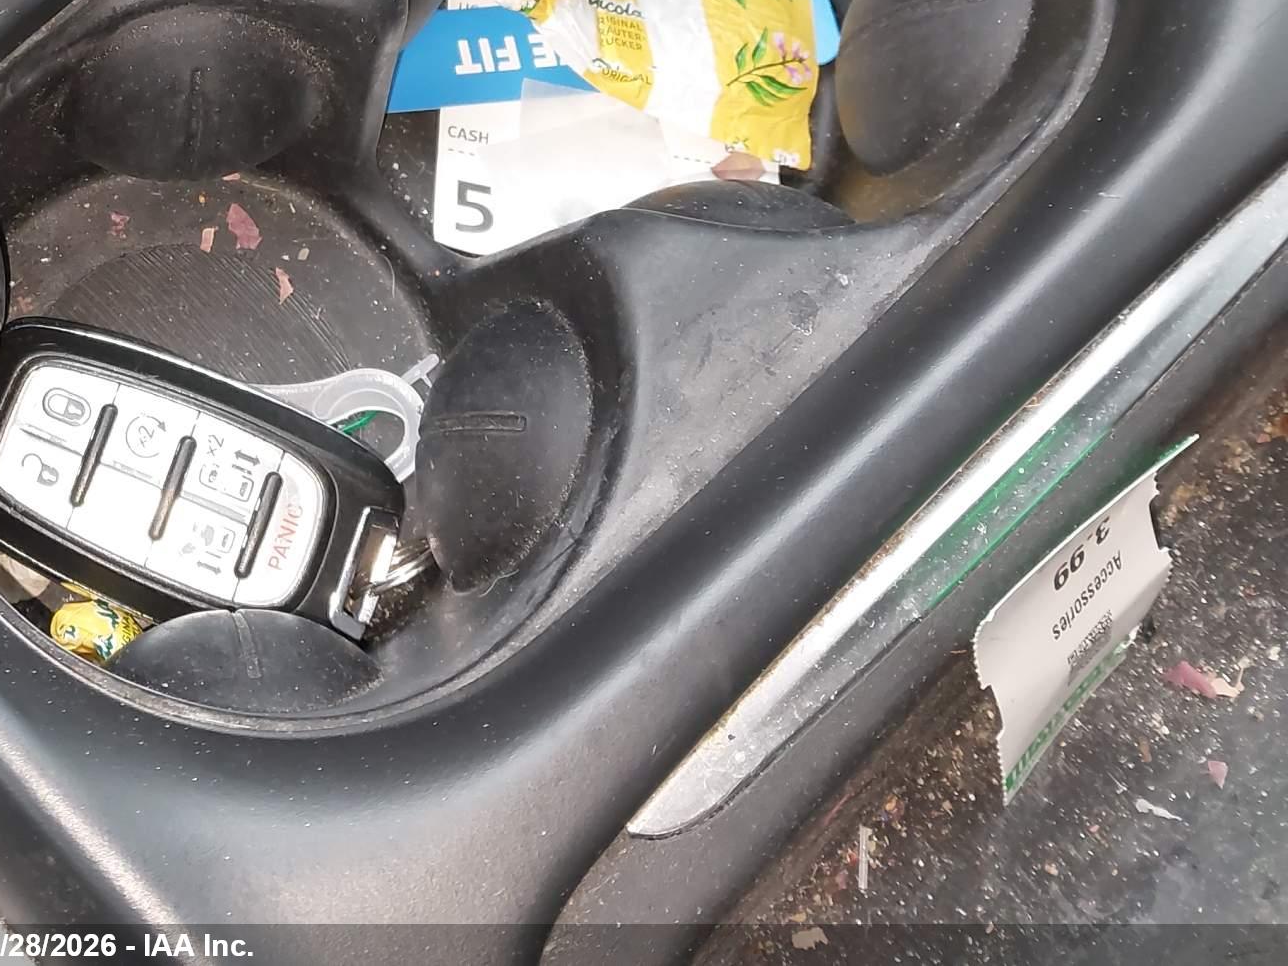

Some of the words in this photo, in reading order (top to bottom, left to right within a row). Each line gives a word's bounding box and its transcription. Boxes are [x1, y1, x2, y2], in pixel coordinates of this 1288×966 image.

[455, 34, 522, 76] FIT
[447, 125, 490, 146] CASH
[455, 179, 495, 233] 5
[267, 502, 304, 571] PANIC
[1051, 550, 1123, 642] Accessories
